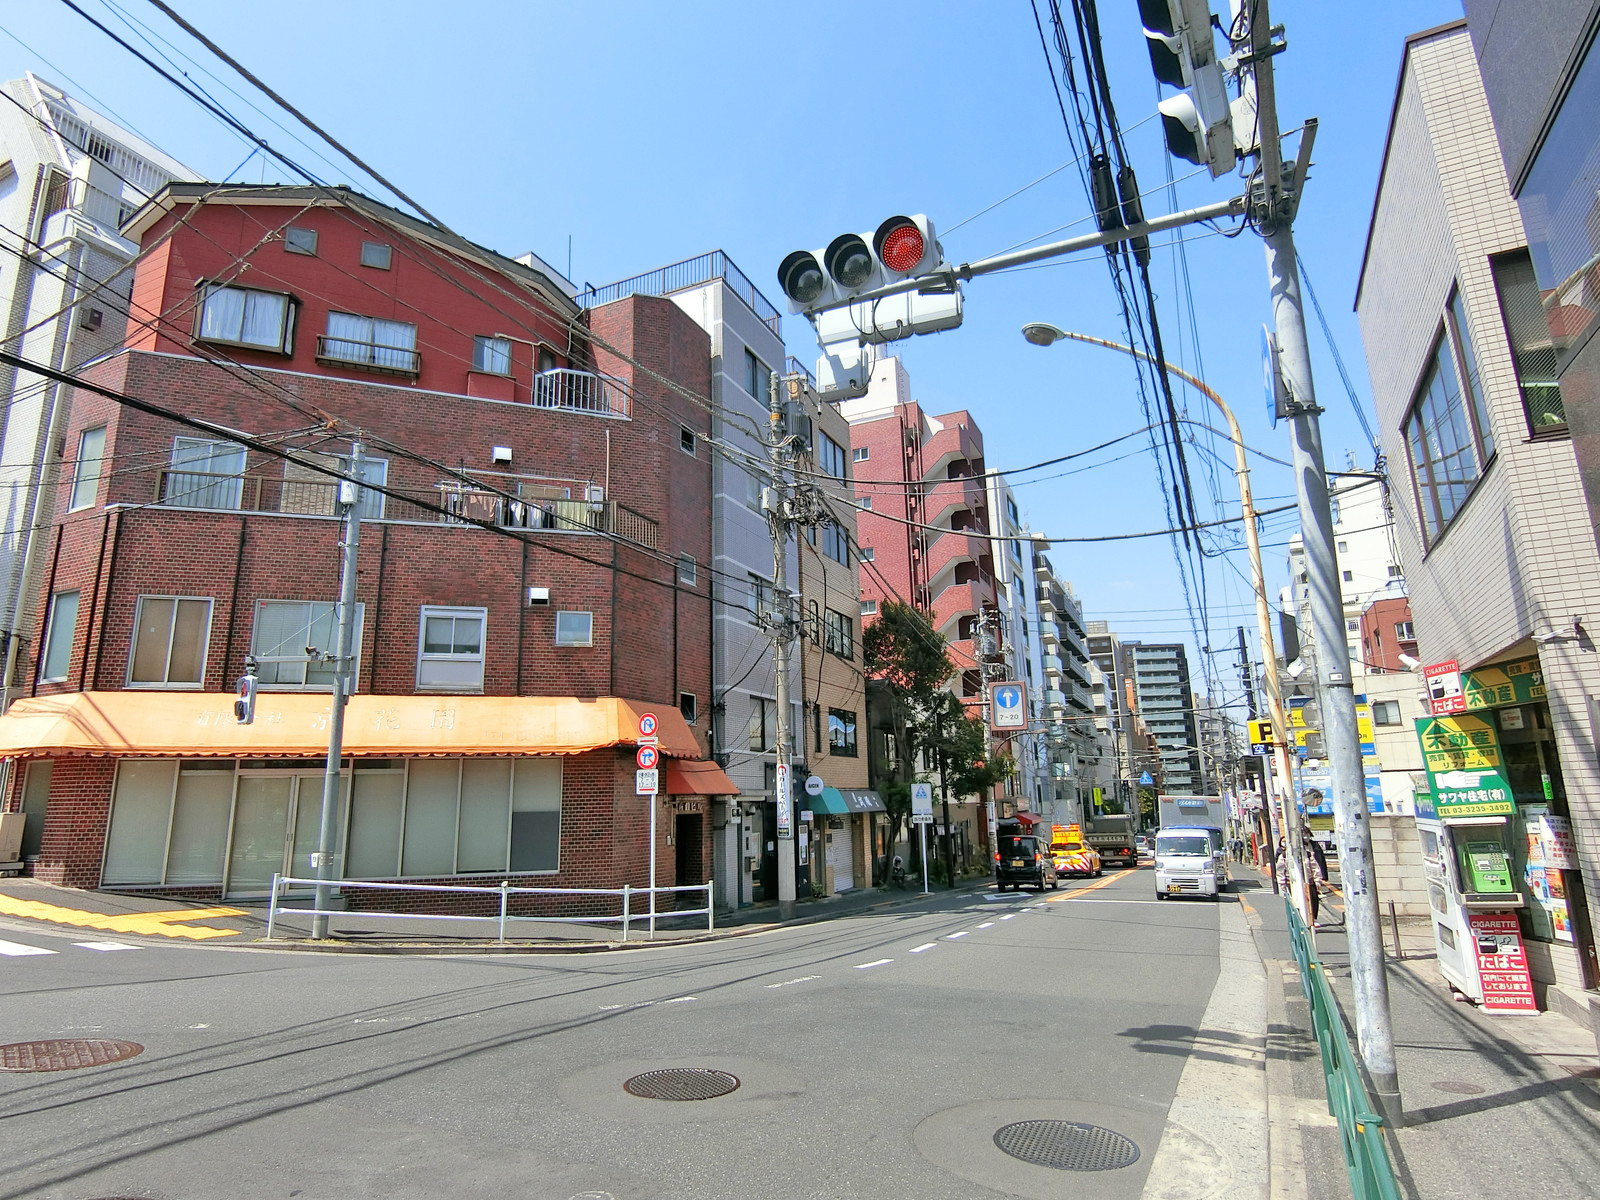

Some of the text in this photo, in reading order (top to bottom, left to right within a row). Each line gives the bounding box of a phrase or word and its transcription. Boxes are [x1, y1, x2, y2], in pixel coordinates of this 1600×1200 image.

[1425, 663, 1457, 676] CIGARETTE
[1467, 685, 1512, 707] 不動産
[1531, 686, 1545, 696] TEL
[1434, 698, 1464, 713] たばこ
[1258, 722, 1273, 741] P
[1426, 730, 1492, 750] 不動産
[1443, 760, 1485, 769] リフォーム
[1438, 788, 1506, 804] サワヤ住宅(有)
[1452, 804, 1510, 814] 03-3235-3492
[1471, 920, 1517, 928] CIGARETTE
[1479, 955, 1525, 969] たばこ
[1485, 995, 1532, 1004] CIGARETTE
